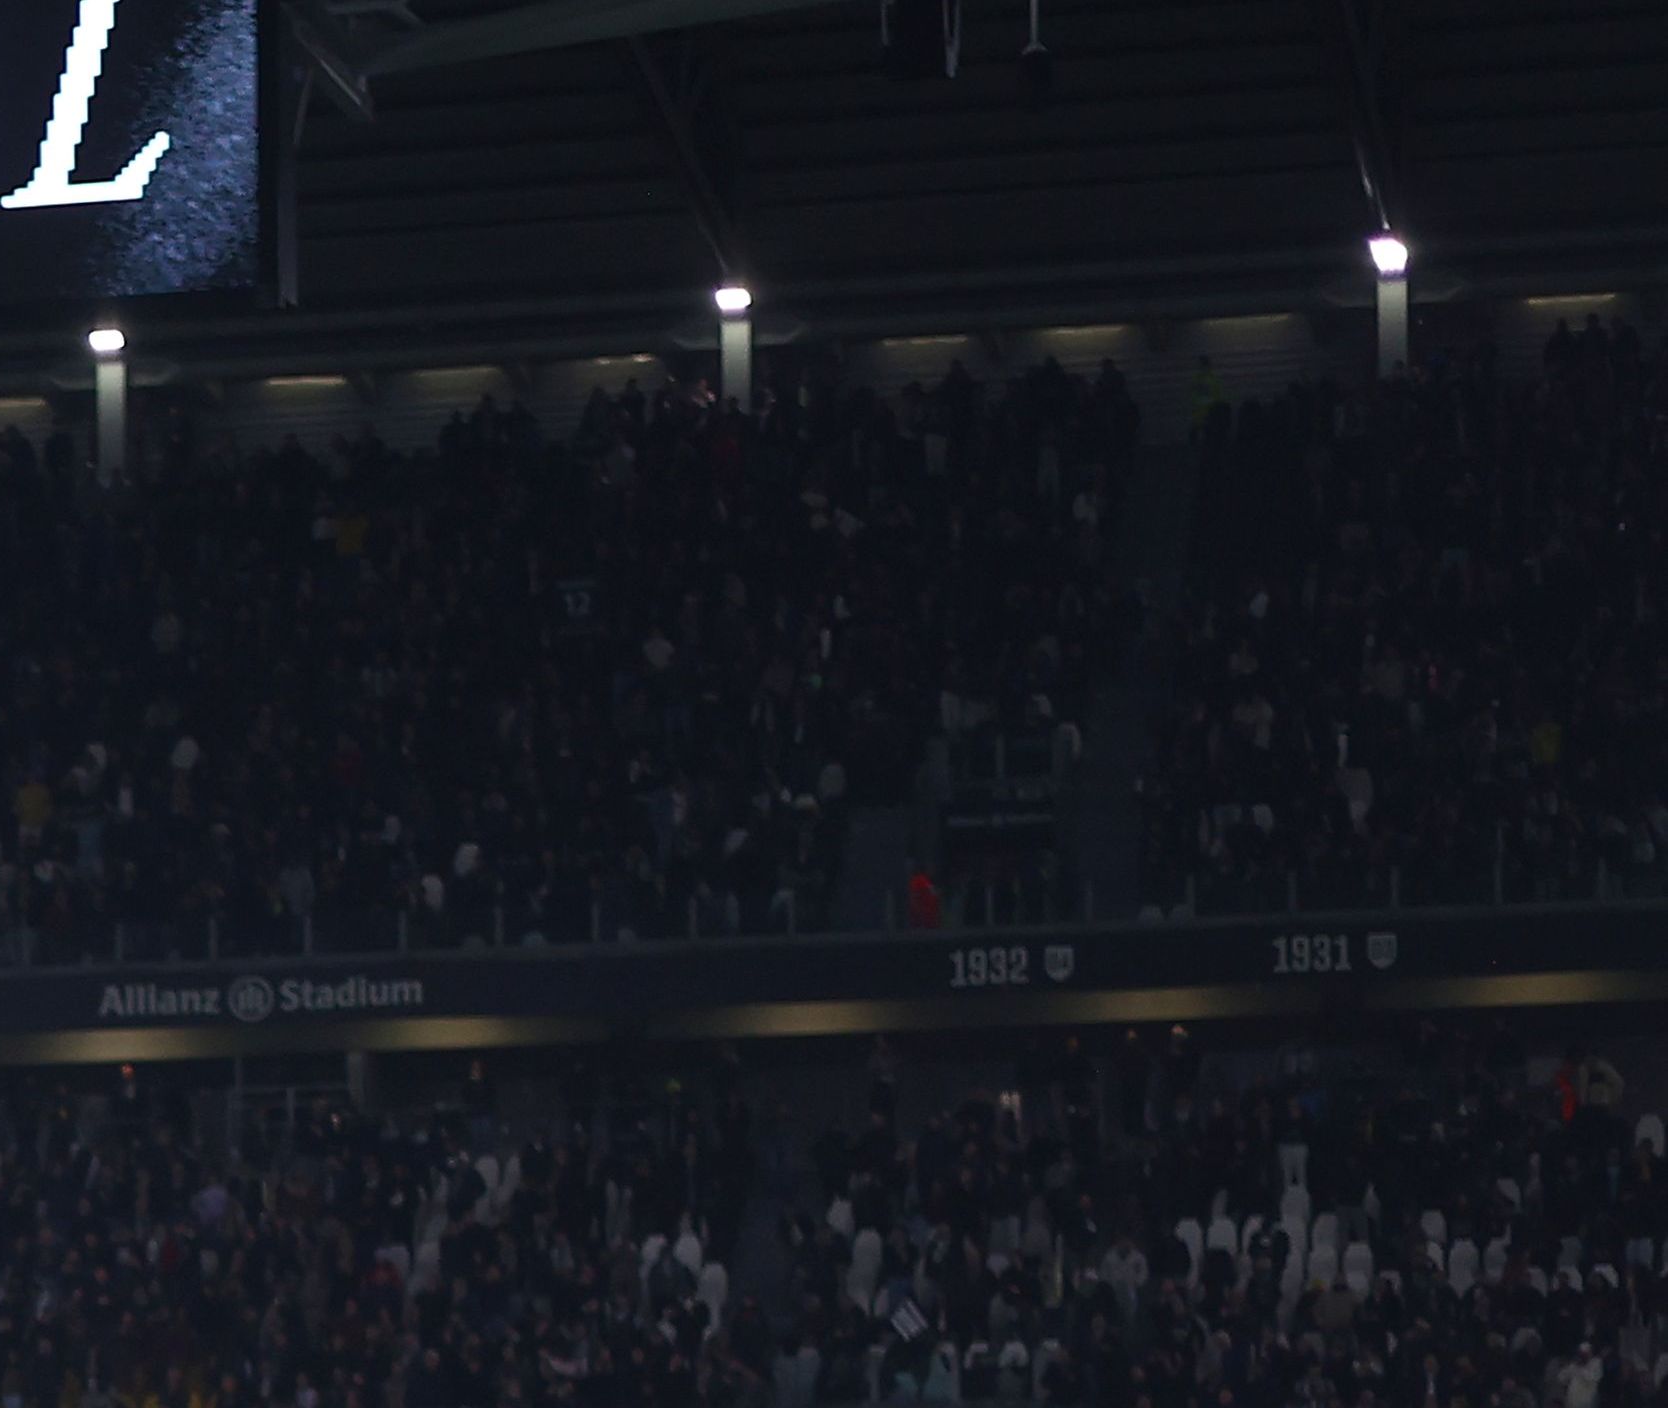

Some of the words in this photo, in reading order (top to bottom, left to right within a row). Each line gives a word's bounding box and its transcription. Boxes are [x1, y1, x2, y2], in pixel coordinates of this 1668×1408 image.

[949, 947, 1029, 987] 1932
[1272, 935, 1351, 972] 1931
[98, 983, 221, 1016] Allianz
[280, 977, 424, 1011] Stadium
